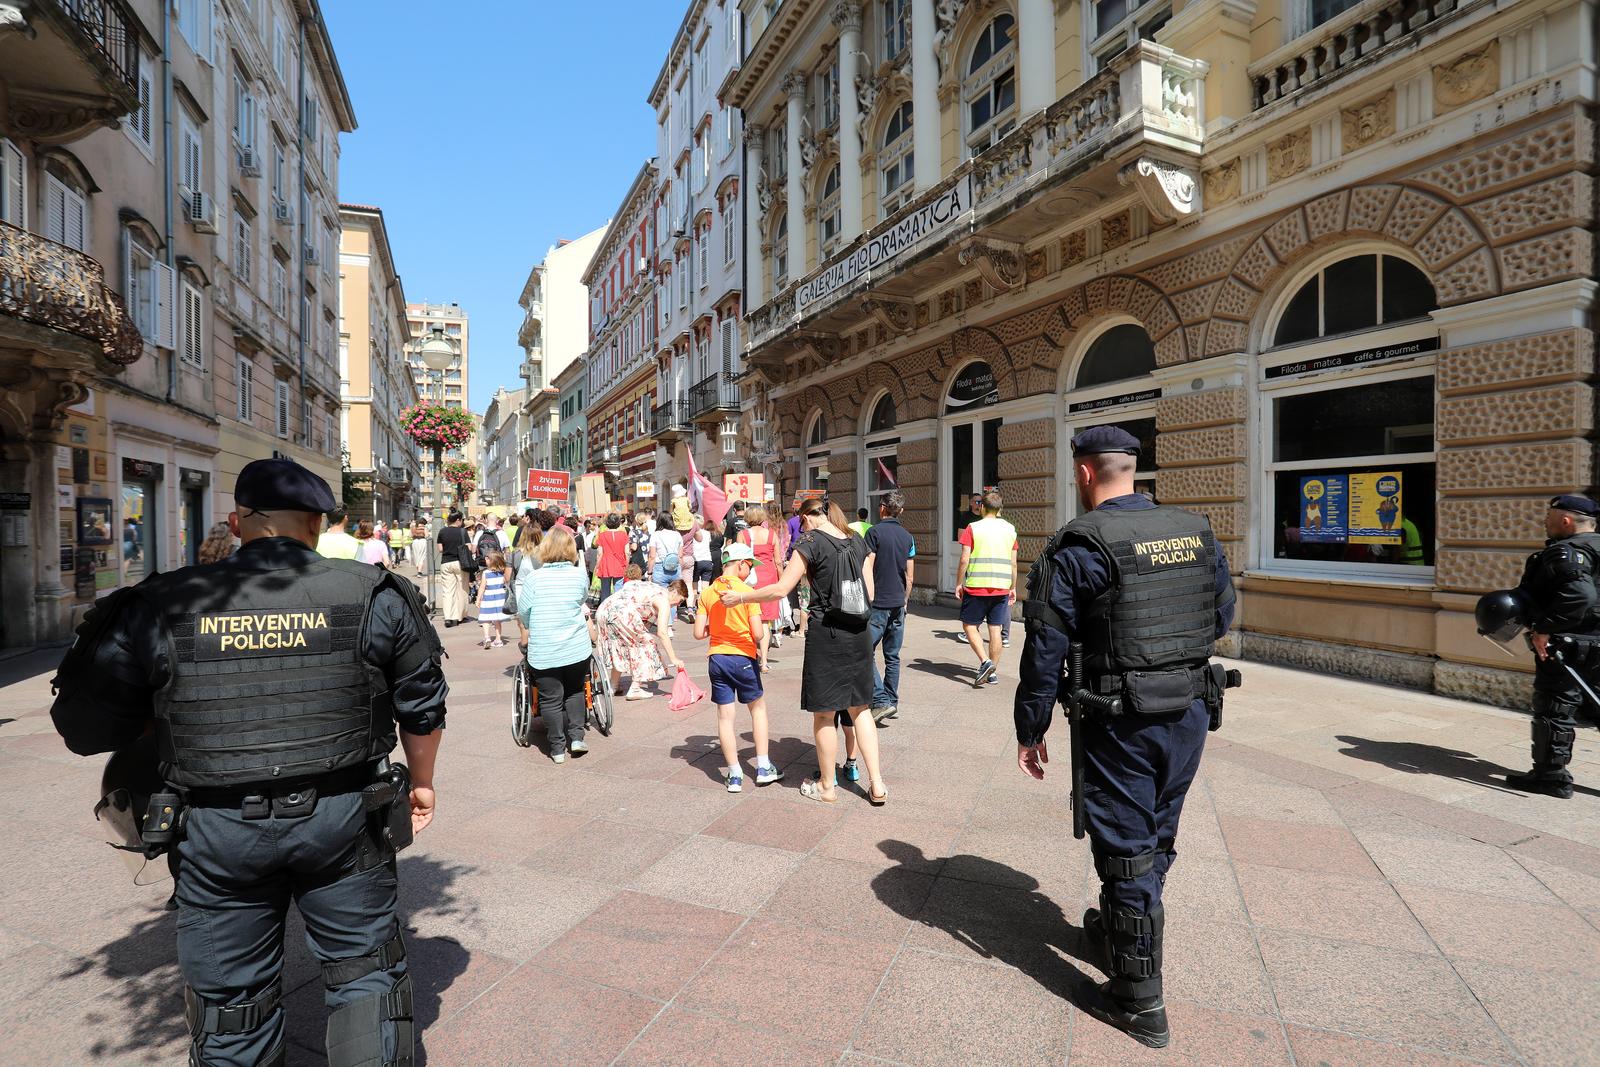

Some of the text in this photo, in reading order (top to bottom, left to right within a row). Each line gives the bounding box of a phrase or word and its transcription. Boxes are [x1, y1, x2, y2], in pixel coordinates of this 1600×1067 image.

[799, 266, 844, 306] GALERIJA
[1375, 350, 1382, 359] &
[1384, 344, 1420, 358] gourmet
[539, 476, 563, 485] ŽIVJETI
[532, 486, 568, 494] SLOBODNO
[1134, 535, 1204, 555] INTERVENTNA
[1150, 550, 1197, 566] POLICIJA
[200, 612, 328, 635] INTERVENTNA
[220, 631, 307, 652] POLICIJA
